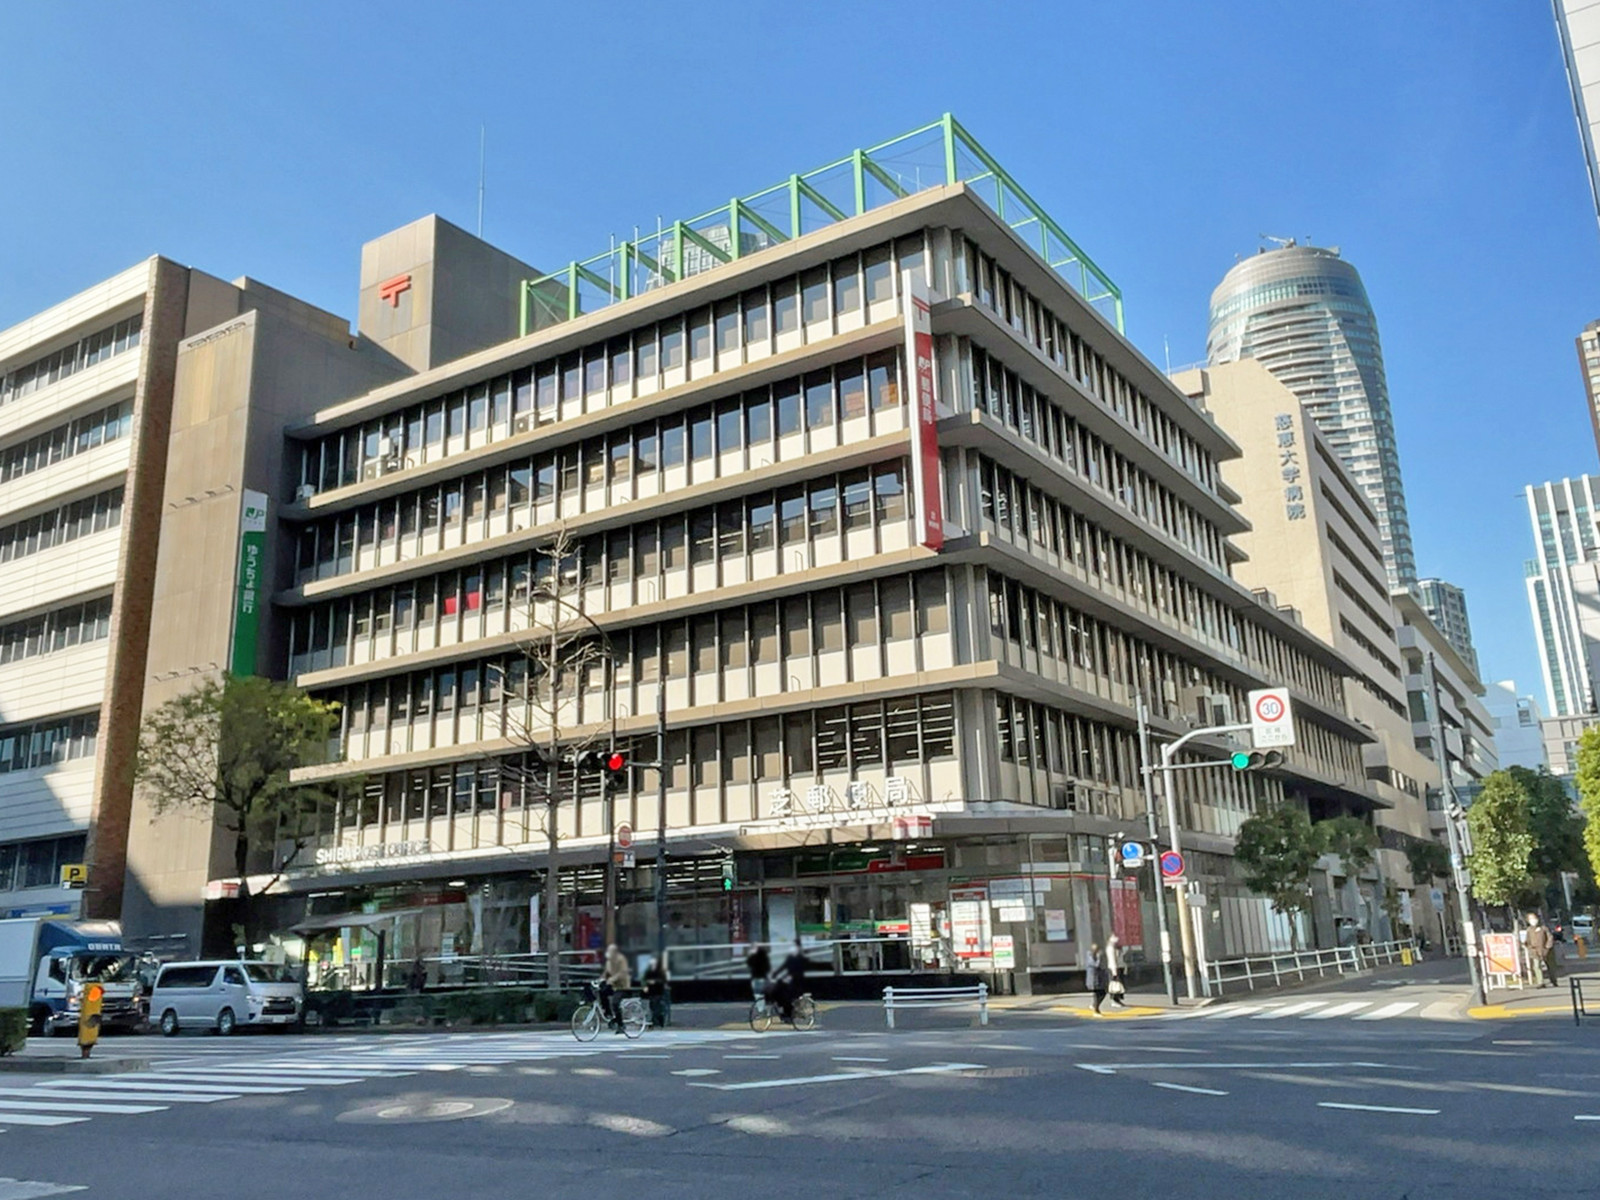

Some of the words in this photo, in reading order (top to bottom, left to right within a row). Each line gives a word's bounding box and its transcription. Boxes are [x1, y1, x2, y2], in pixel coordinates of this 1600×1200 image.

[1274, 412, 1307, 522] 慈恵大学病院
[242, 544, 259, 615] ゆうちょ銀行
[1262, 701, 1280, 716] 30
[768, 776, 908, 817] 芝郵便局
[69, 867, 81, 880] P
